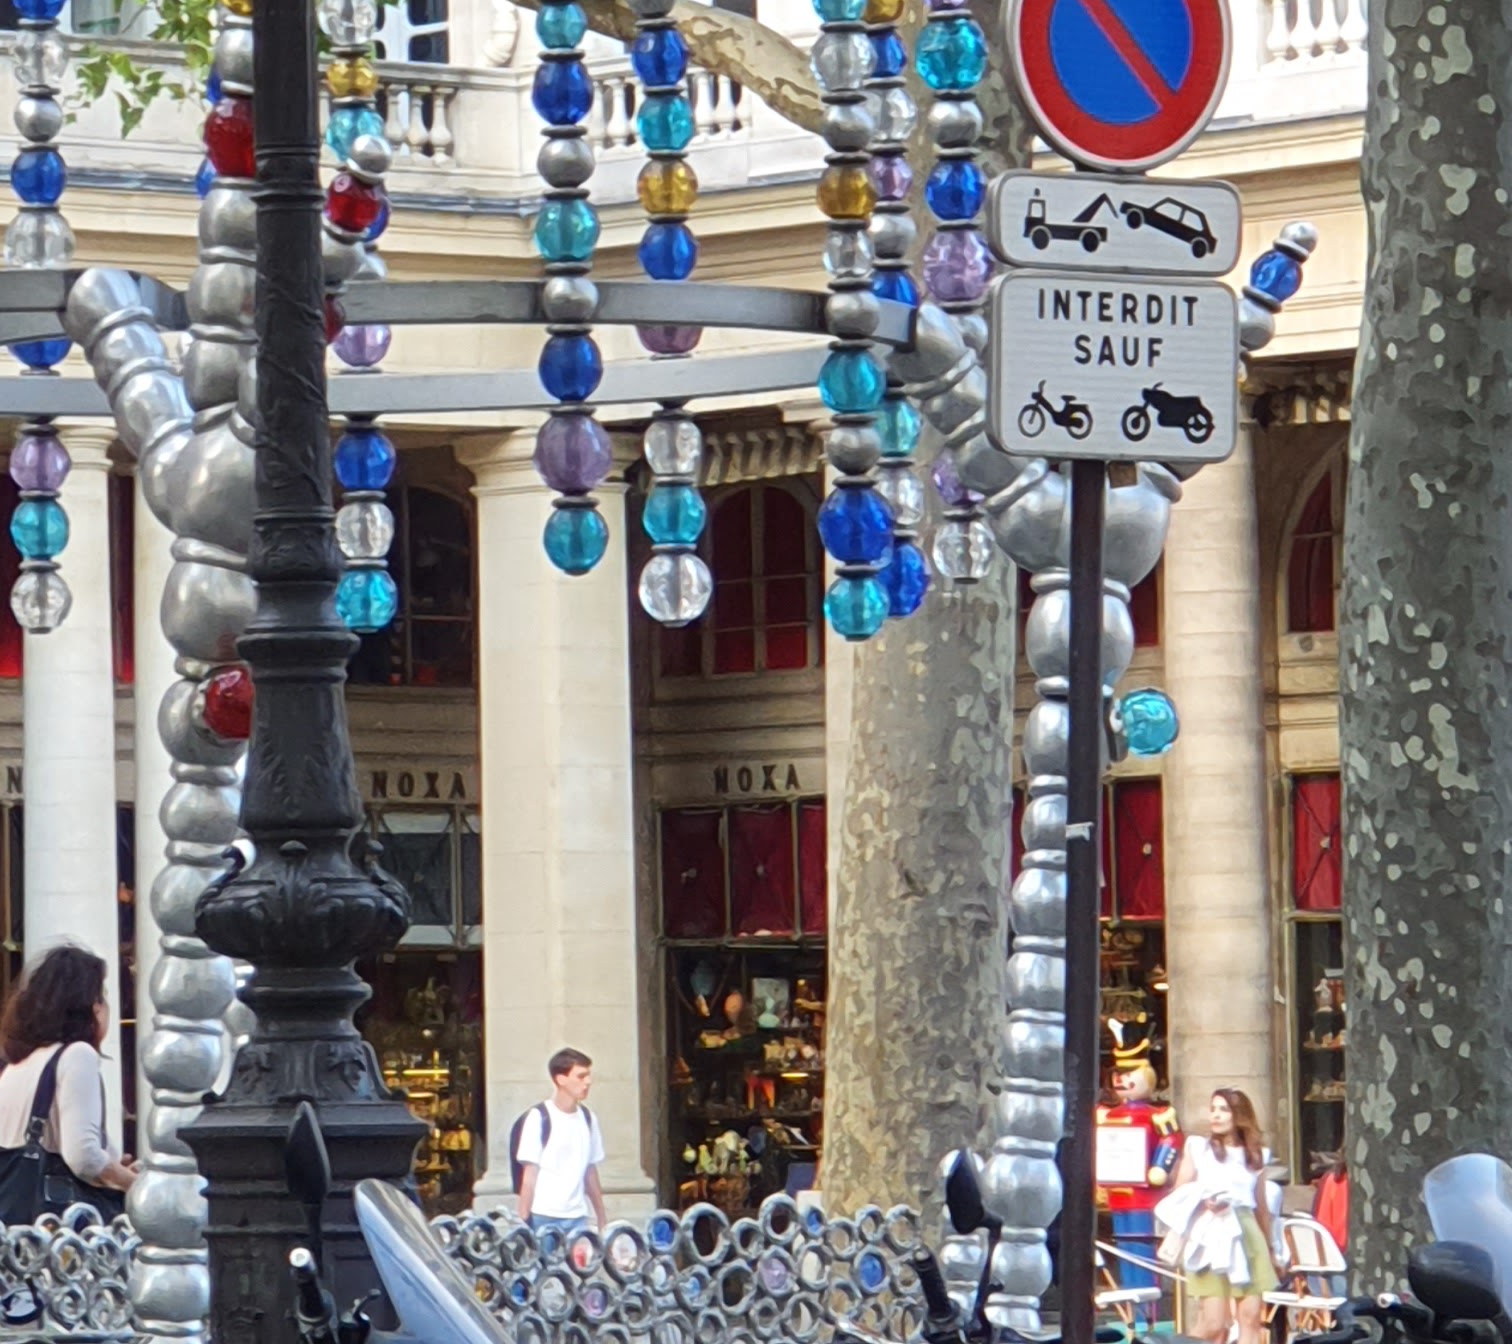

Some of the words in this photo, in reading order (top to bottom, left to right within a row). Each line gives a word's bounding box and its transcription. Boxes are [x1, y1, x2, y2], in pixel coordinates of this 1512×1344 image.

[1038, 288, 1199, 327] INTERDIT
[1074, 334, 1164, 368] SAUF
[371, 770, 467, 799] NOXA
[712, 763, 801, 794] NOXA
